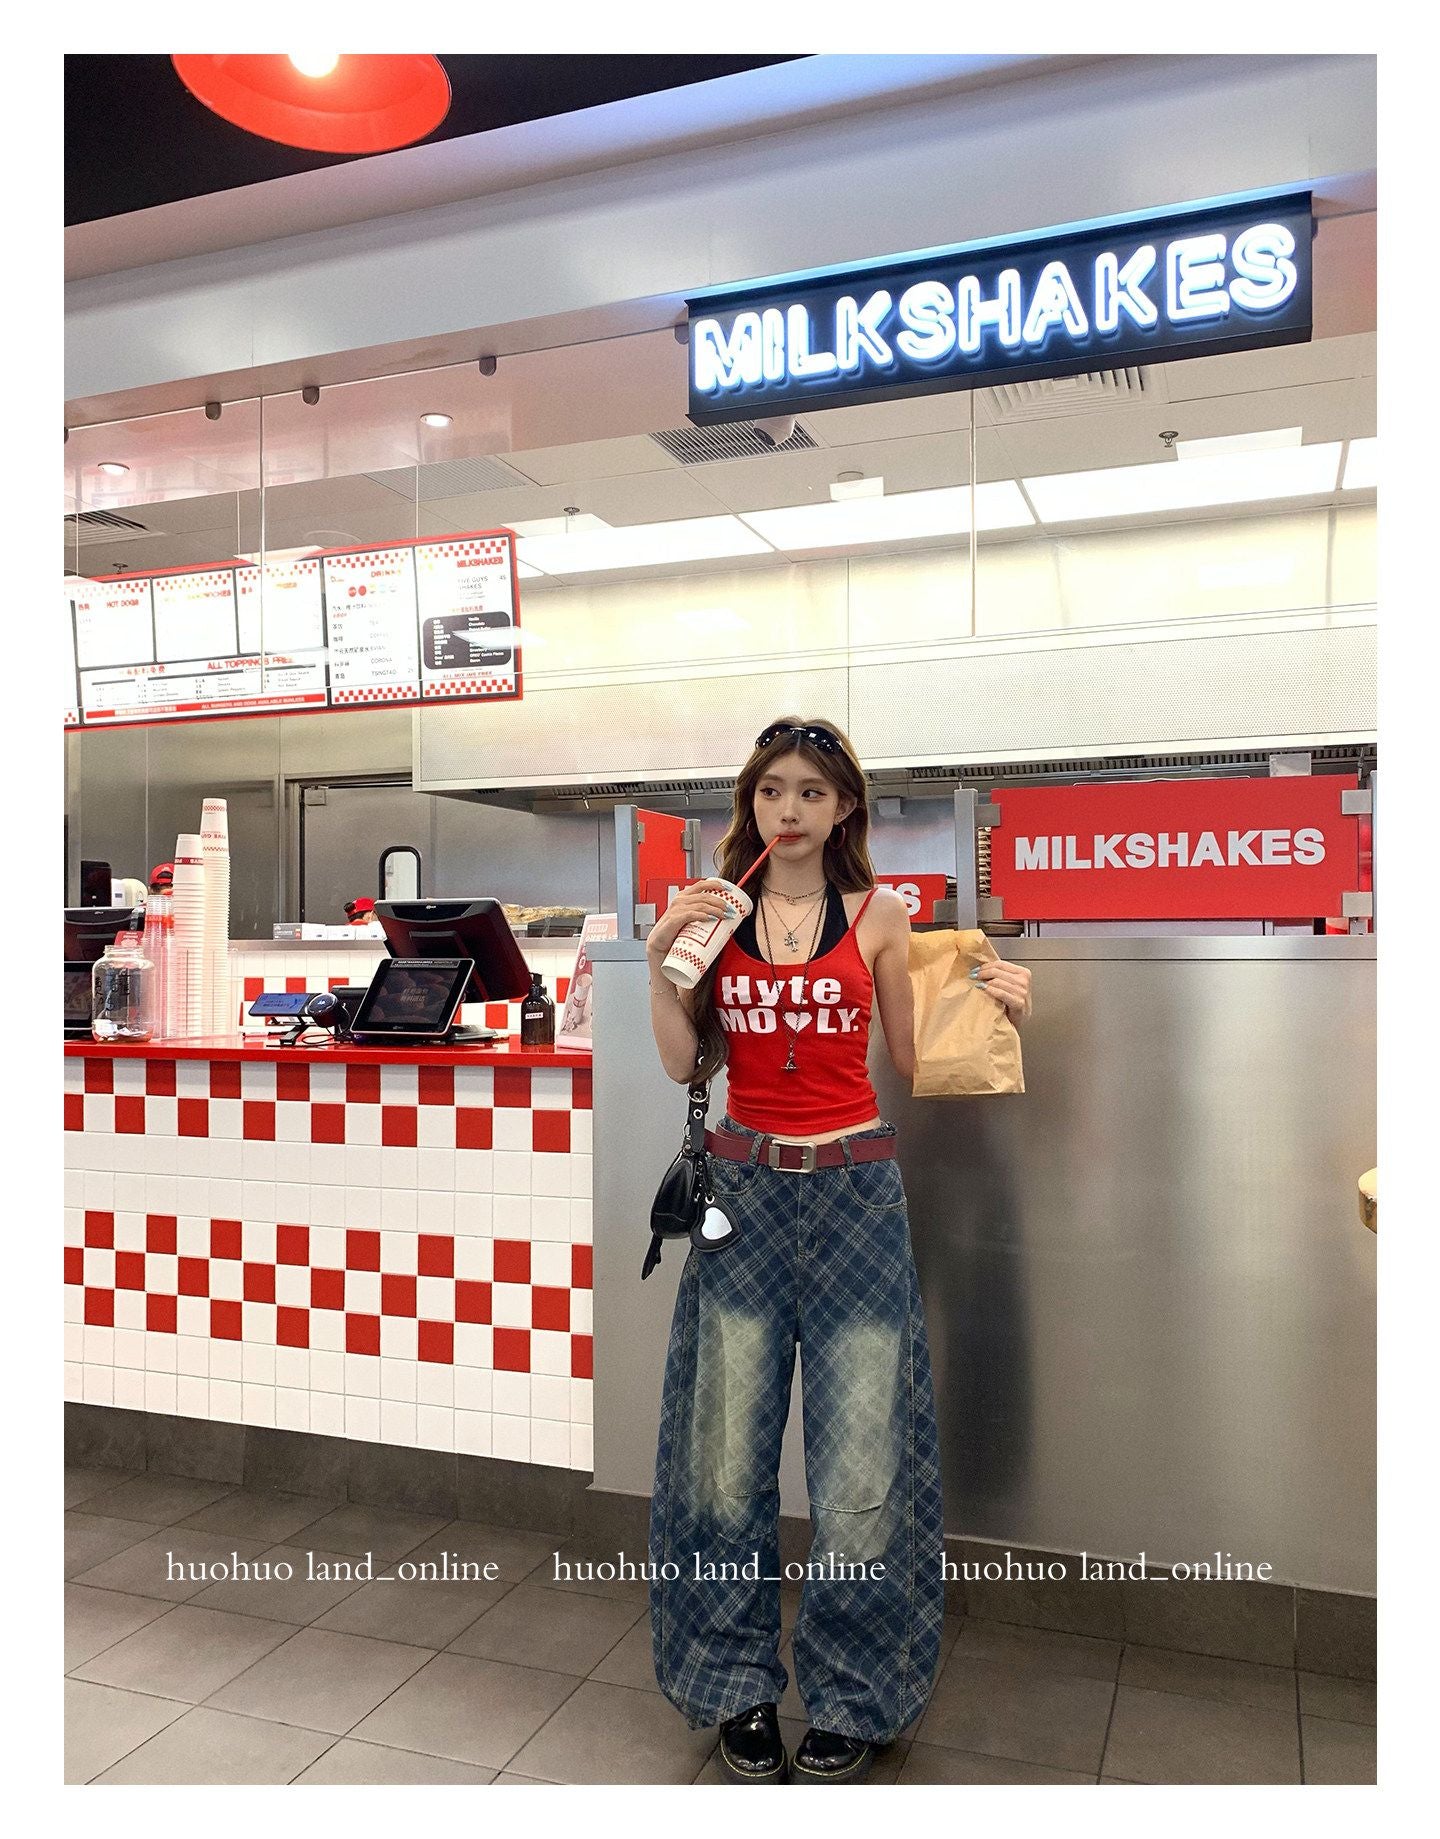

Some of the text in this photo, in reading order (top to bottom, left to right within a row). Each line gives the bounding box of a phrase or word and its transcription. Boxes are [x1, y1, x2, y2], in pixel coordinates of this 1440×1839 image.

[694, 223, 1298, 393] MILKSHAKES
[456, 556, 504, 568] MILKSHAKES
[106, 598, 139, 609] HOT DOGS
[207, 661, 223, 671] ALL
[224, 656, 270, 670] TOPPINGS
[1014, 827, 1326, 871] MILKSHAKES
[721, 975, 842, 1007] Hyte
